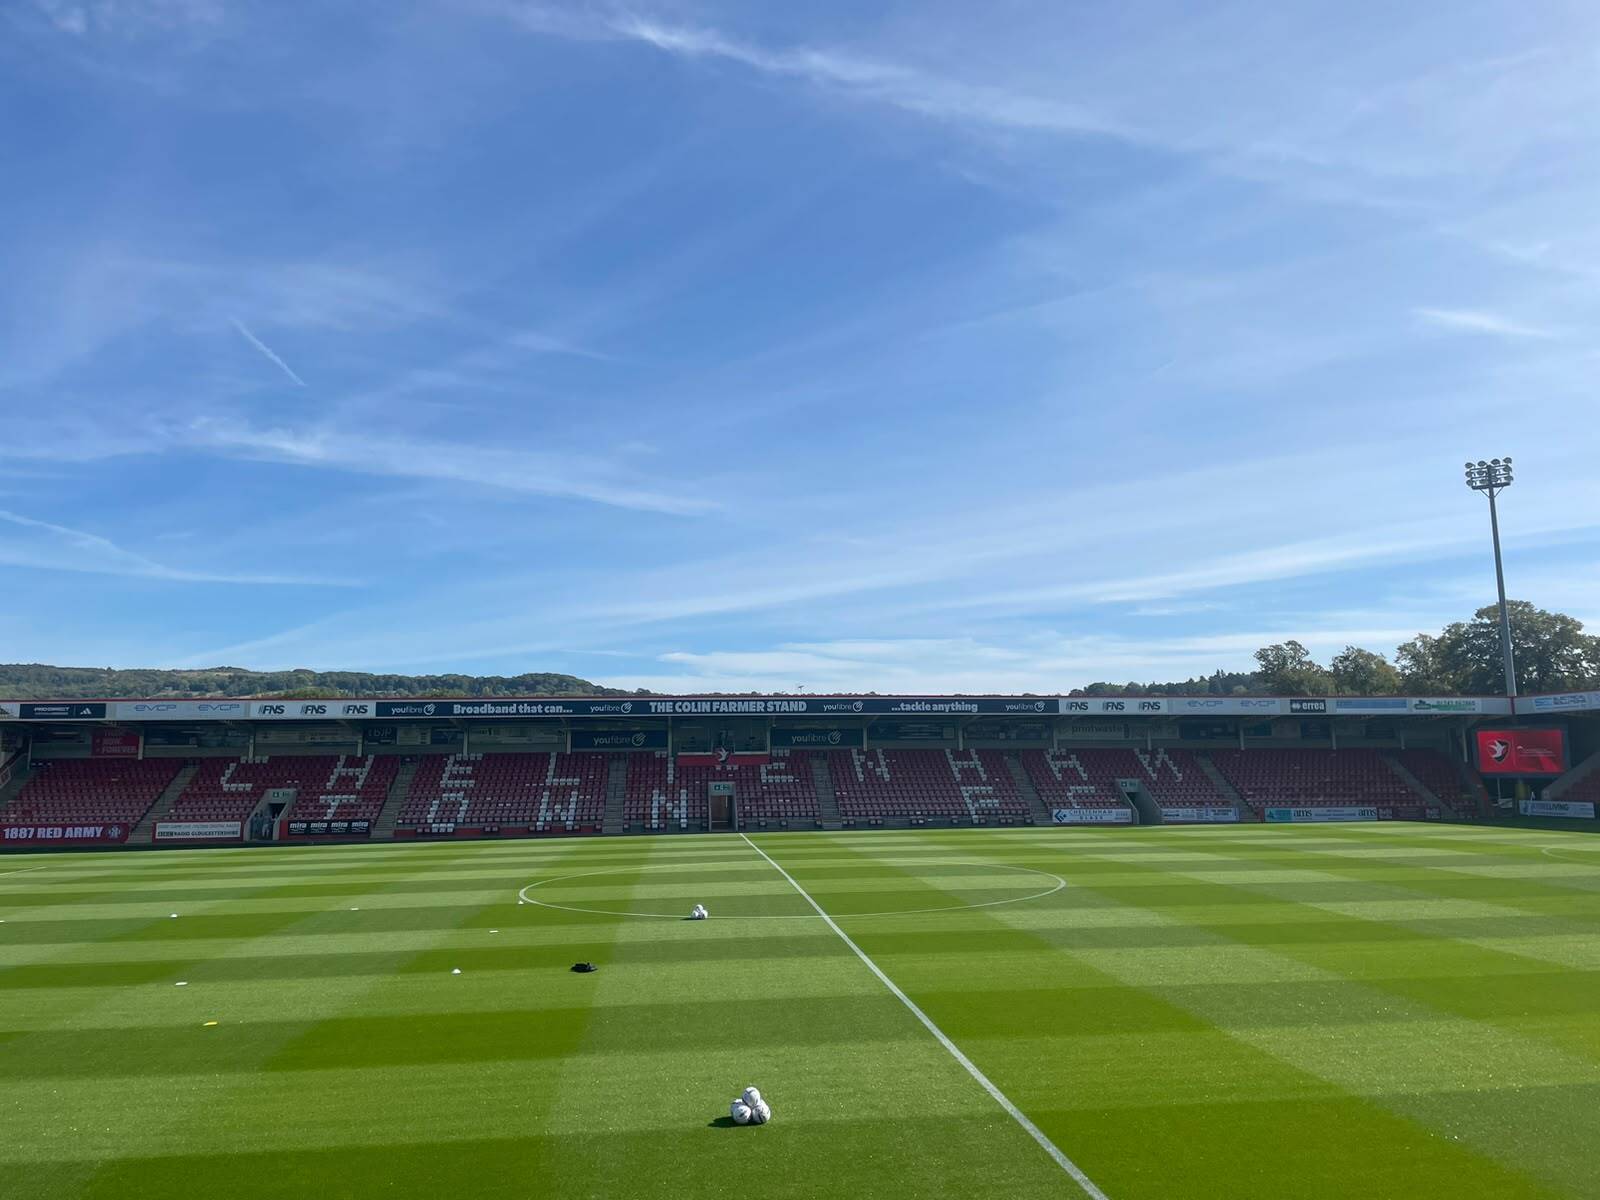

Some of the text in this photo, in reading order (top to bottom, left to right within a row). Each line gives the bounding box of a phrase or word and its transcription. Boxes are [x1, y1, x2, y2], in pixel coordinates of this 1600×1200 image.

[453, 703, 573, 714] Broadband that can...
[590, 703, 620, 713] youfibre
[649, 701, 807, 713] THE COLIN FARMER STAND
[823, 702, 851, 712] youfibre
[932, 701, 978, 713] anything
[593, 735, 631, 747] youfibre
[791, 733, 828, 745] youfibre
[289, 821, 307, 829] mira
[310, 821, 328, 829] mira
[330, 820, 349, 828] mira
[351, 820, 369, 828] mira
[3, 826, 104, 840] 1887 RED ARMY
